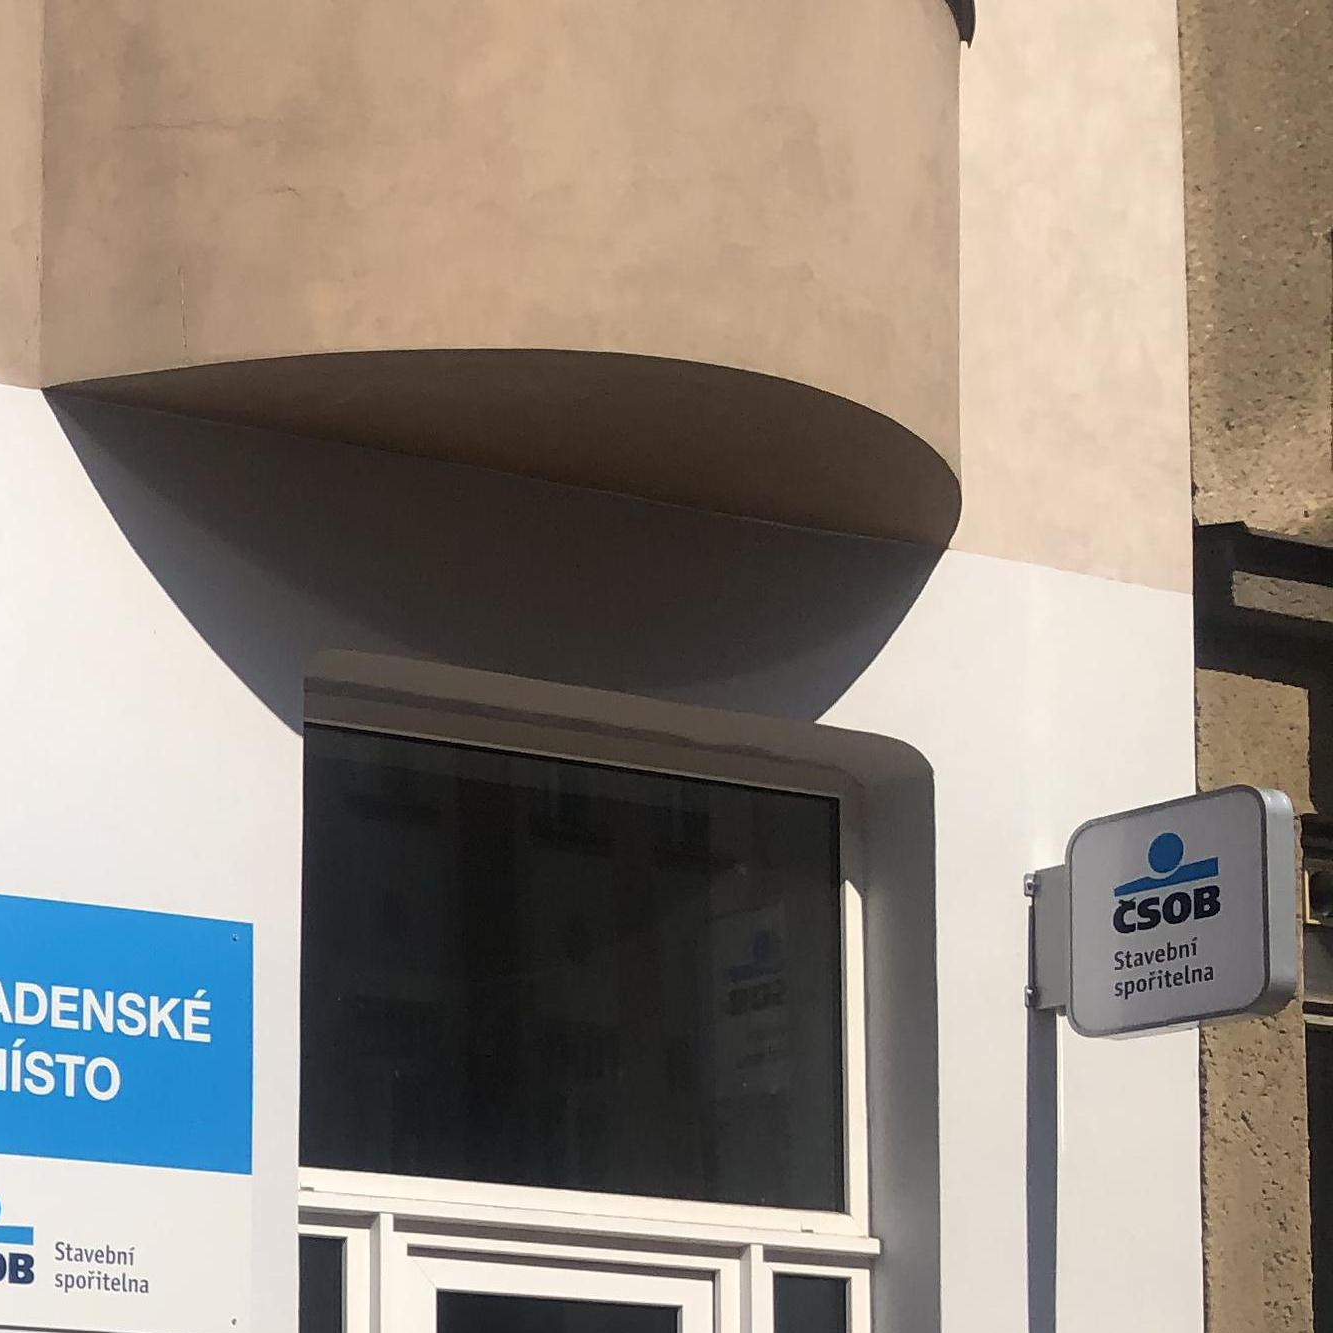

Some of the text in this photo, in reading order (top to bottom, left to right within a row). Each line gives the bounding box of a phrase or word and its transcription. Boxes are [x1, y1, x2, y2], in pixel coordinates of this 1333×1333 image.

[1113, 885, 1221, 934] ČSOB
[1114, 937, 1198, 971] Stavební
[1114, 965, 1214, 1000] spořitelna
[54, 1241, 135, 1266] Stavební
[54, 1269, 150, 1294] spořitelna
